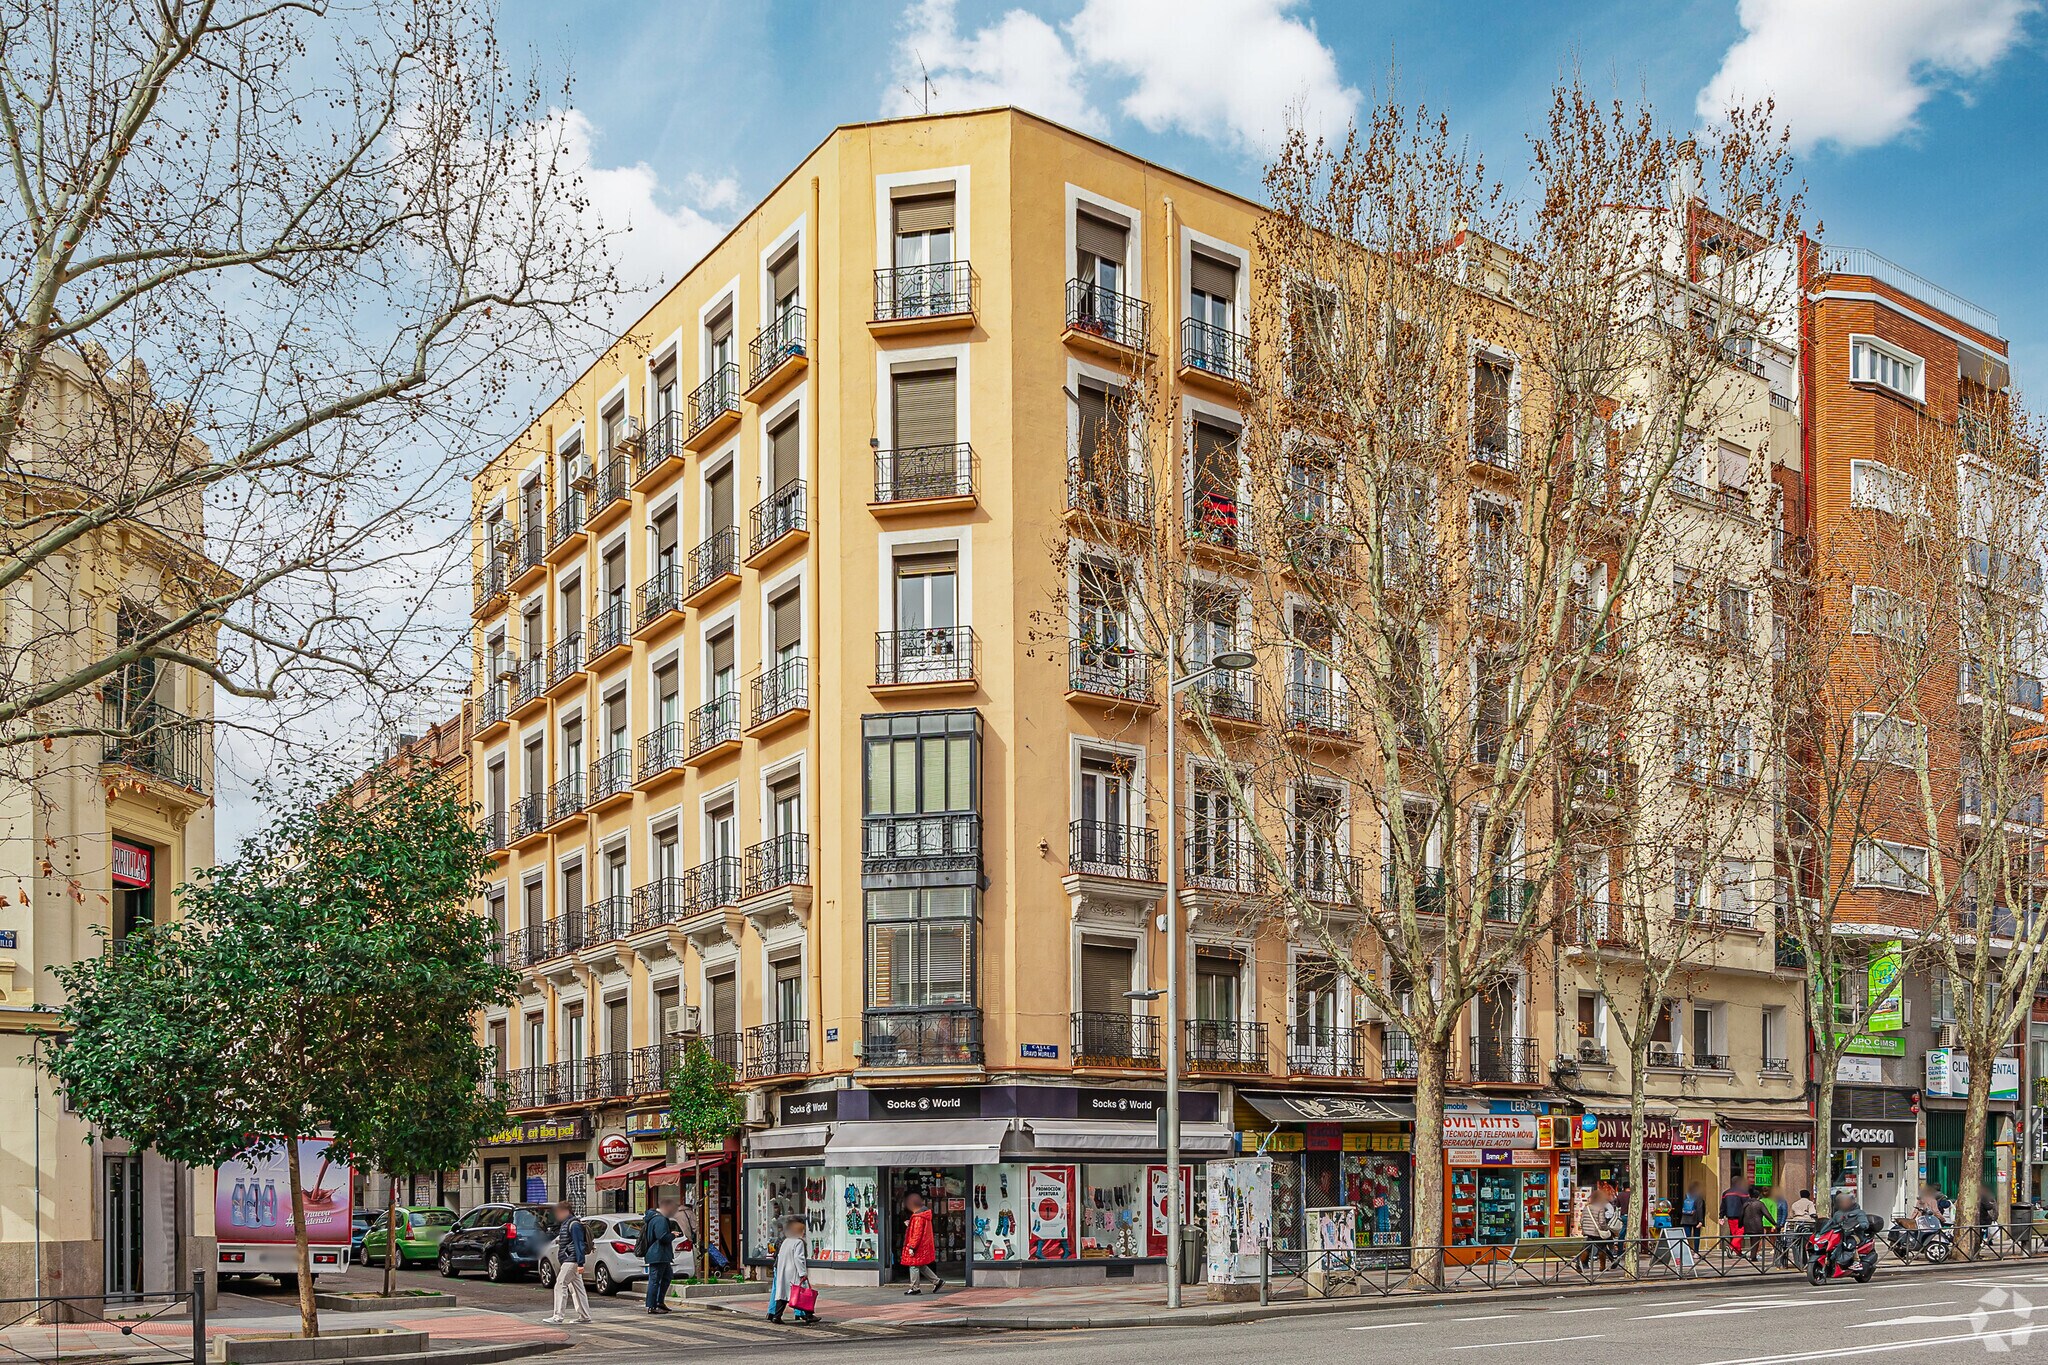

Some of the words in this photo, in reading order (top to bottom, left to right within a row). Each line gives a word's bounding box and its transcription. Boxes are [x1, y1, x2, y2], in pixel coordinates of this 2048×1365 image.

[112, 847, 147, 882] RRILLAS
[1838, 1036, 1872, 1046] GUPO
[1952, 1060, 1969, 1073] CLIN
[1992, 1063, 2017, 1075] ENTAL
[789, 1104, 806, 1114] Socks
[812, 1102, 828, 1112] World
[886, 1099, 917, 1110] Socks
[932, 1098, 961, 1109] World
[1092, 1098, 1117, 1109] Socks
[1129, 1099, 1152, 1110] World
[1443, 1115, 1476, 1128] ÓVIL
[1480, 1116, 1520, 1129] KITTS
[1474, 1130, 1482, 1138] DE
[1598, 1120, 1616, 1138] ON
[1622, 1121, 1666, 1139] KBAP
[1841, 1123, 1895, 1143] Season
[1442, 1138, 1475, 1147] BERACIÓN
[1476, 1139, 1485, 1147] EN
[1486, 1139, 1494, 1147] EL
[1494, 1139, 1512, 1147] ACTO
[1721, 1133, 1756, 1143] CREACIONES
[1757, 1131, 1806, 1146] GRIJALBA
[1642, 1140, 1669, 1150] riginales
[1373, 1233, 1401, 1243] OFERTA
